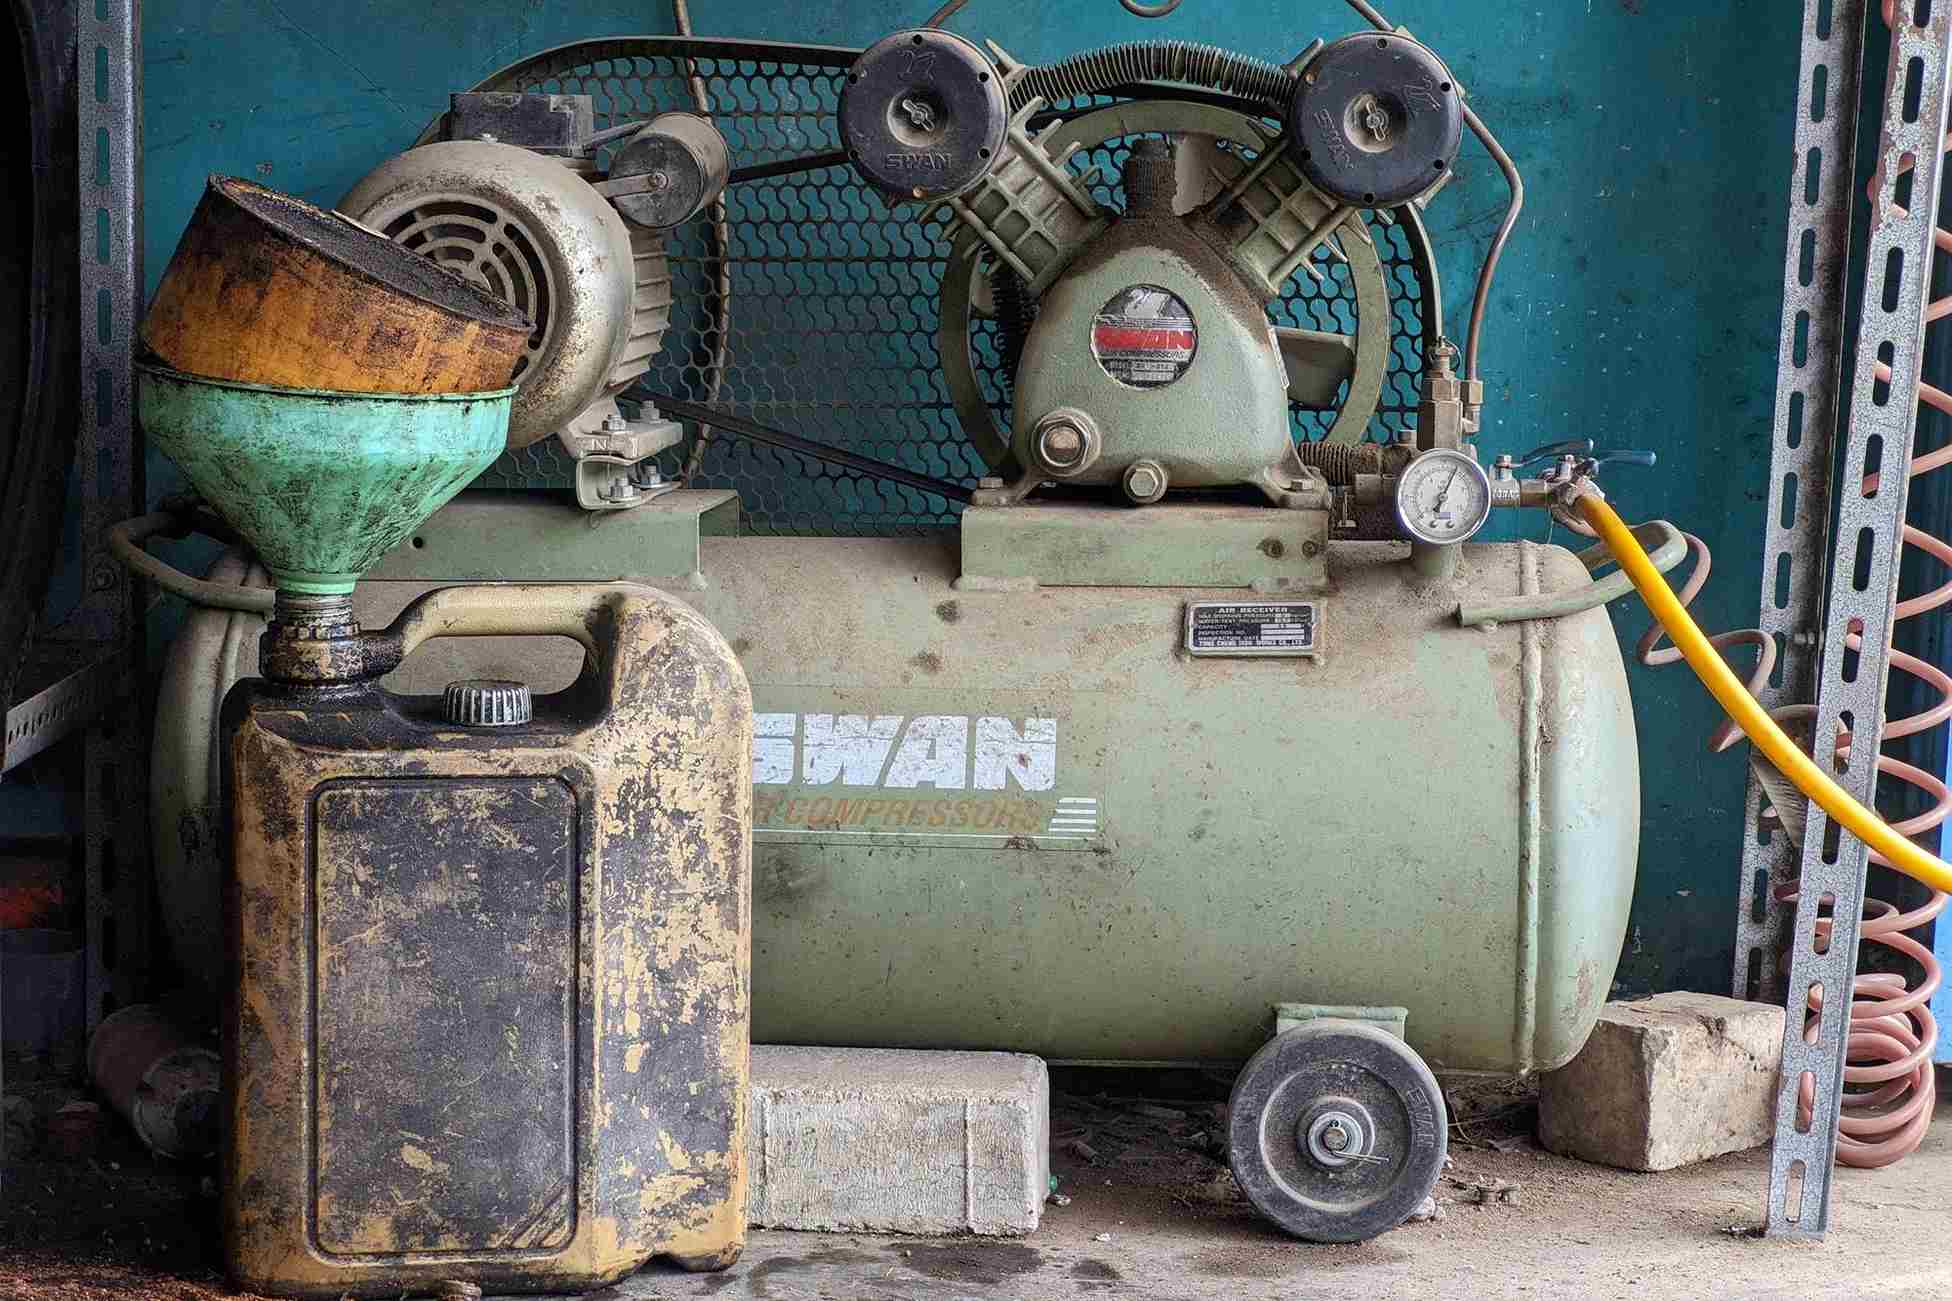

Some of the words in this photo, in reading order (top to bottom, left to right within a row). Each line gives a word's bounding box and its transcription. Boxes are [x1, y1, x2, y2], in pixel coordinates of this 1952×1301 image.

[886, 152, 953, 169] SWAN
[752, 712, 1057, 791] SWAN
[783, 796, 1042, 834] COMPRESSORS
